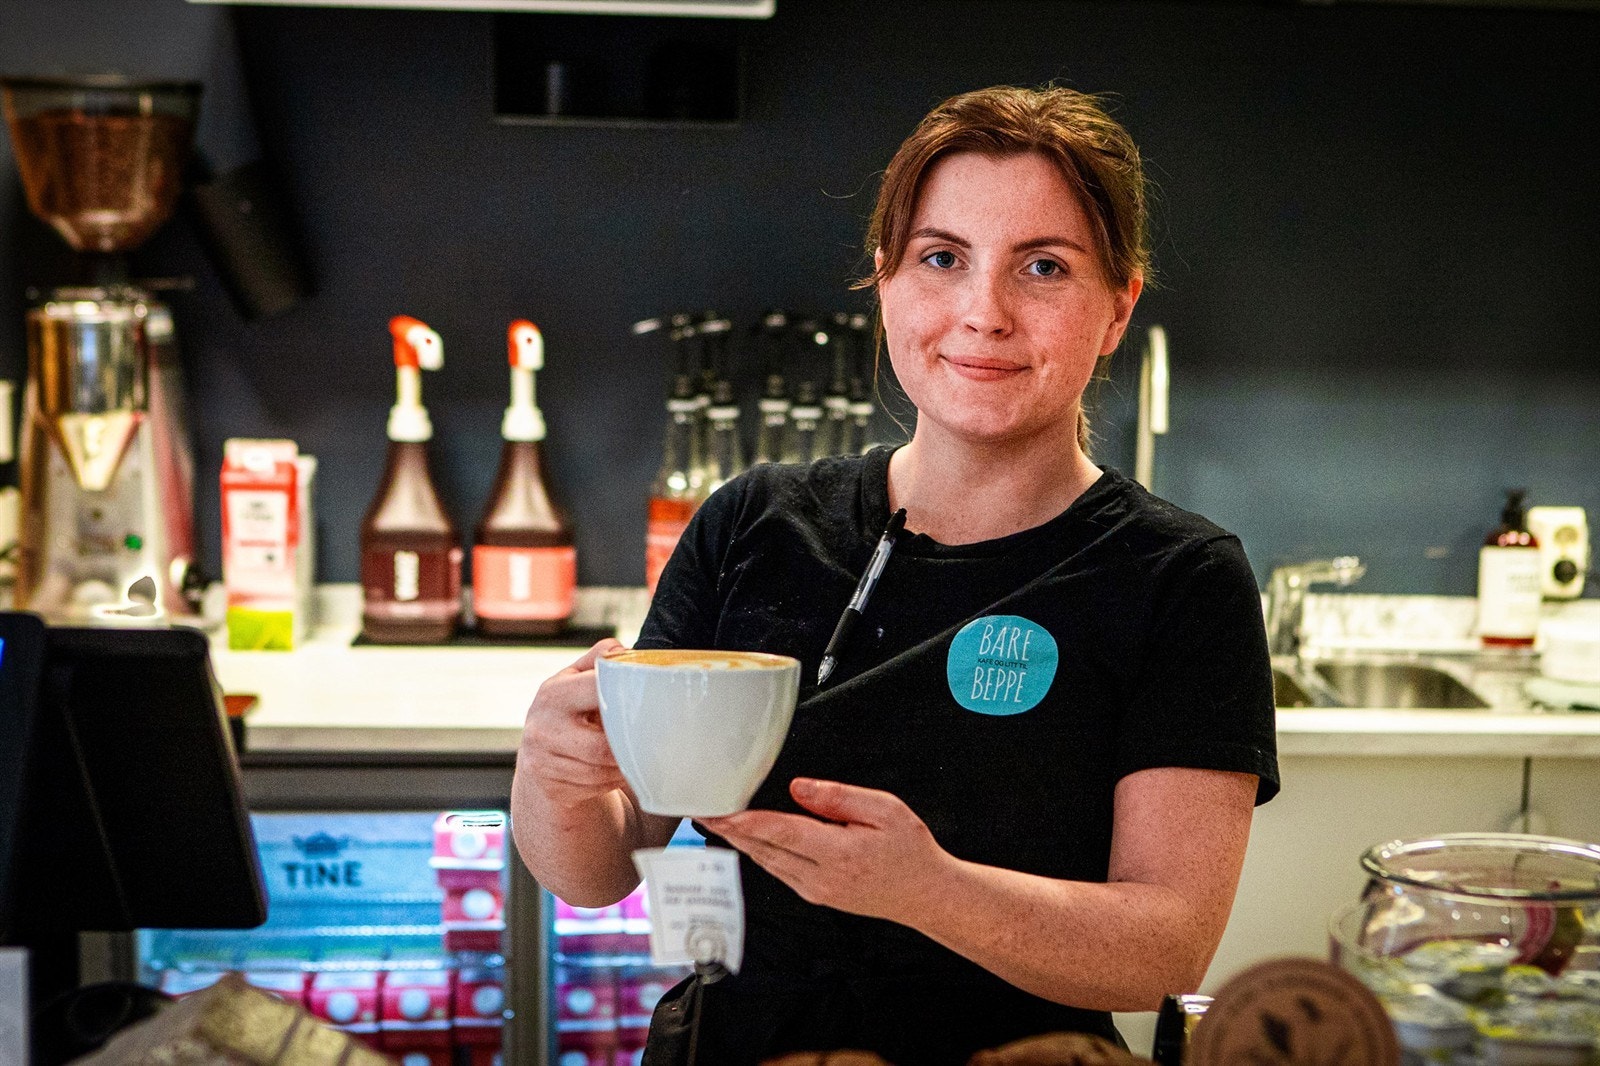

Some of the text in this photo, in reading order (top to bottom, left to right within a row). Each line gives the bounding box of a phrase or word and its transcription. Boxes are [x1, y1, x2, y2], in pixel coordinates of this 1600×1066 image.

[979, 624, 1033, 661] BARE
[994, 659, 1004, 667] OG
[971, 666, 1027, 702] BEPPE
[282, 861, 362, 888] TINE
